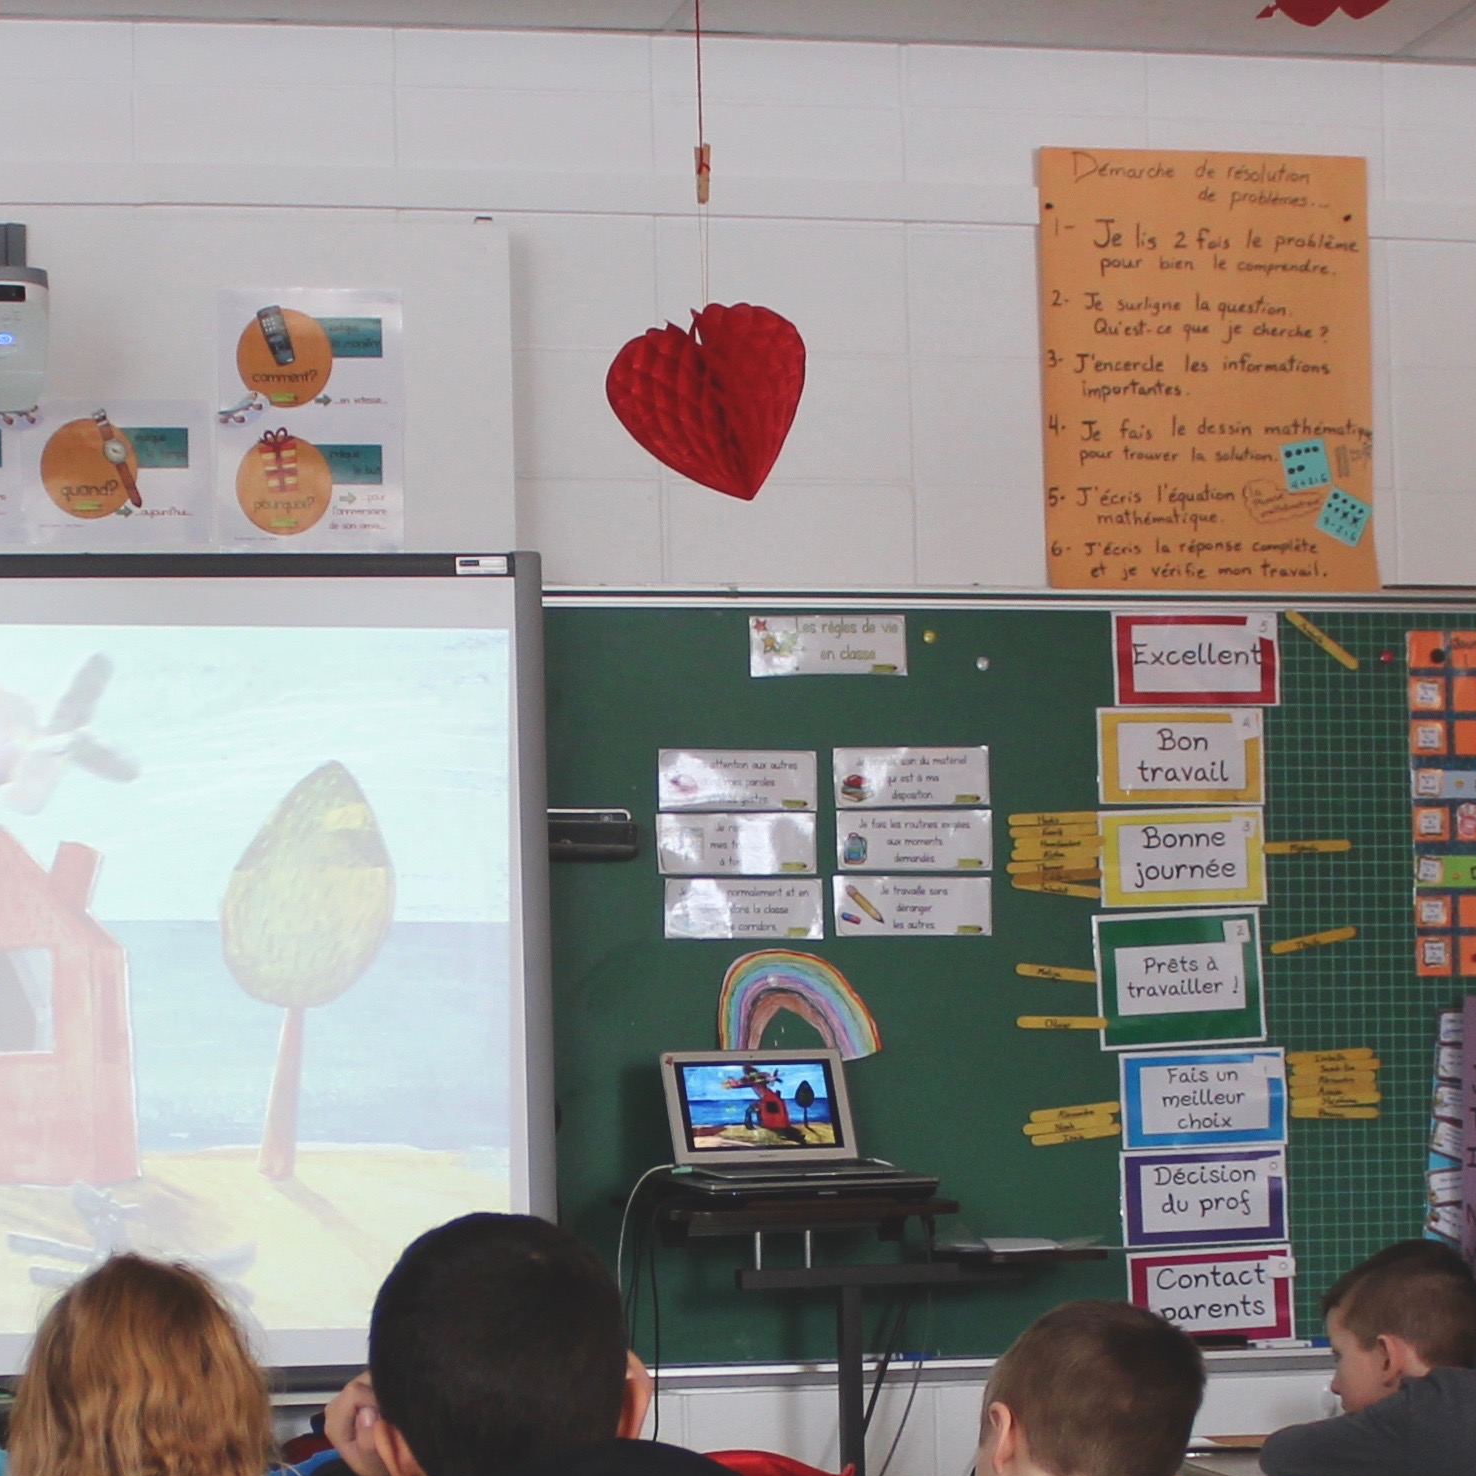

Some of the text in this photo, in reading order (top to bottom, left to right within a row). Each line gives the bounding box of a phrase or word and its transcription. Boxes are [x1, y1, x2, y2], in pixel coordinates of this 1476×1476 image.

[1072, 152, 1310, 184] Démarche de résolution
[1198, 188, 1215, 202] de
[1094, 219, 1358, 253] Je lis 2 fois le problème
[1101, 252, 1336, 276] pour bien le comprendre.
[1085, 292, 1102, 310] Je
[1119, 298, 1180, 315] surligne
[1196, 294, 1209, 312] la
[1184, 323, 1208, 341] que
[1224, 320, 1241, 343] je
[1075, 352, 1330, 374] J'encercle les informations
[253, 369, 317, 383] comment?
[1083, 379, 1190, 400] importantes.
[1080, 417, 1252, 441] Je fais le dessin
[1080, 449, 1278, 465] pour trouver la solution.
[61, 480, 118, 501] quand?
[1077, 489, 1140, 506] J'écris
[1158, 484, 1234, 511] l'équation
[253, 497, 315, 514] pourquoi?
[1085, 540, 1318, 559] J'écris la réponse complète
[1091, 563, 1327, 582] et je vérifie mon travail.
[795, 617, 898, 638] Les règles de vie
[1260, 618, 1268, 631] 5
[821, 644, 875, 659] en classe
[1132, 643, 1264, 666] Excellent
[1157, 728, 1209, 752] Bon
[710, 760, 748, 770] attention
[771, 762, 797, 770] autres
[920, 756, 966, 765] du matériel
[887, 775, 897, 787] qui
[917, 774, 922, 782] à
[1138, 761, 1229, 782] travail
[745, 778, 775, 787] paroles
[716, 824, 726, 832] Je
[859, 820, 867, 829] Je
[872, 819, 886, 829] fais
[890, 819, 901, 829] les
[905, 820, 937, 829] routines
[905, 837, 942, 846] moments
[1142, 827, 1226, 849] Bonne
[1135, 860, 1236, 888] journée
[881, 886, 948, 895] Je travaille sans
[753, 905, 761, 913] la
[764, 905, 788, 913] classe
[897, 904, 932, 915] déranger
[894, 920, 903, 929] les
[1236, 925, 1245, 936] 2
[1144, 956, 1218, 975] Prêts à
[1127, 979, 1223, 998] travailler
[1168, 1067, 1238, 1084] Fais un
[1162, 1090, 1245, 1107] meilleur
[1178, 1112, 1233, 1129] choix
[1154, 1165, 1256, 1186] Décision
[1162, 1191, 1252, 1218] du prof
[1156, 1264, 1266, 1290] Contact
[1160, 1297, 1265, 1321] parents
